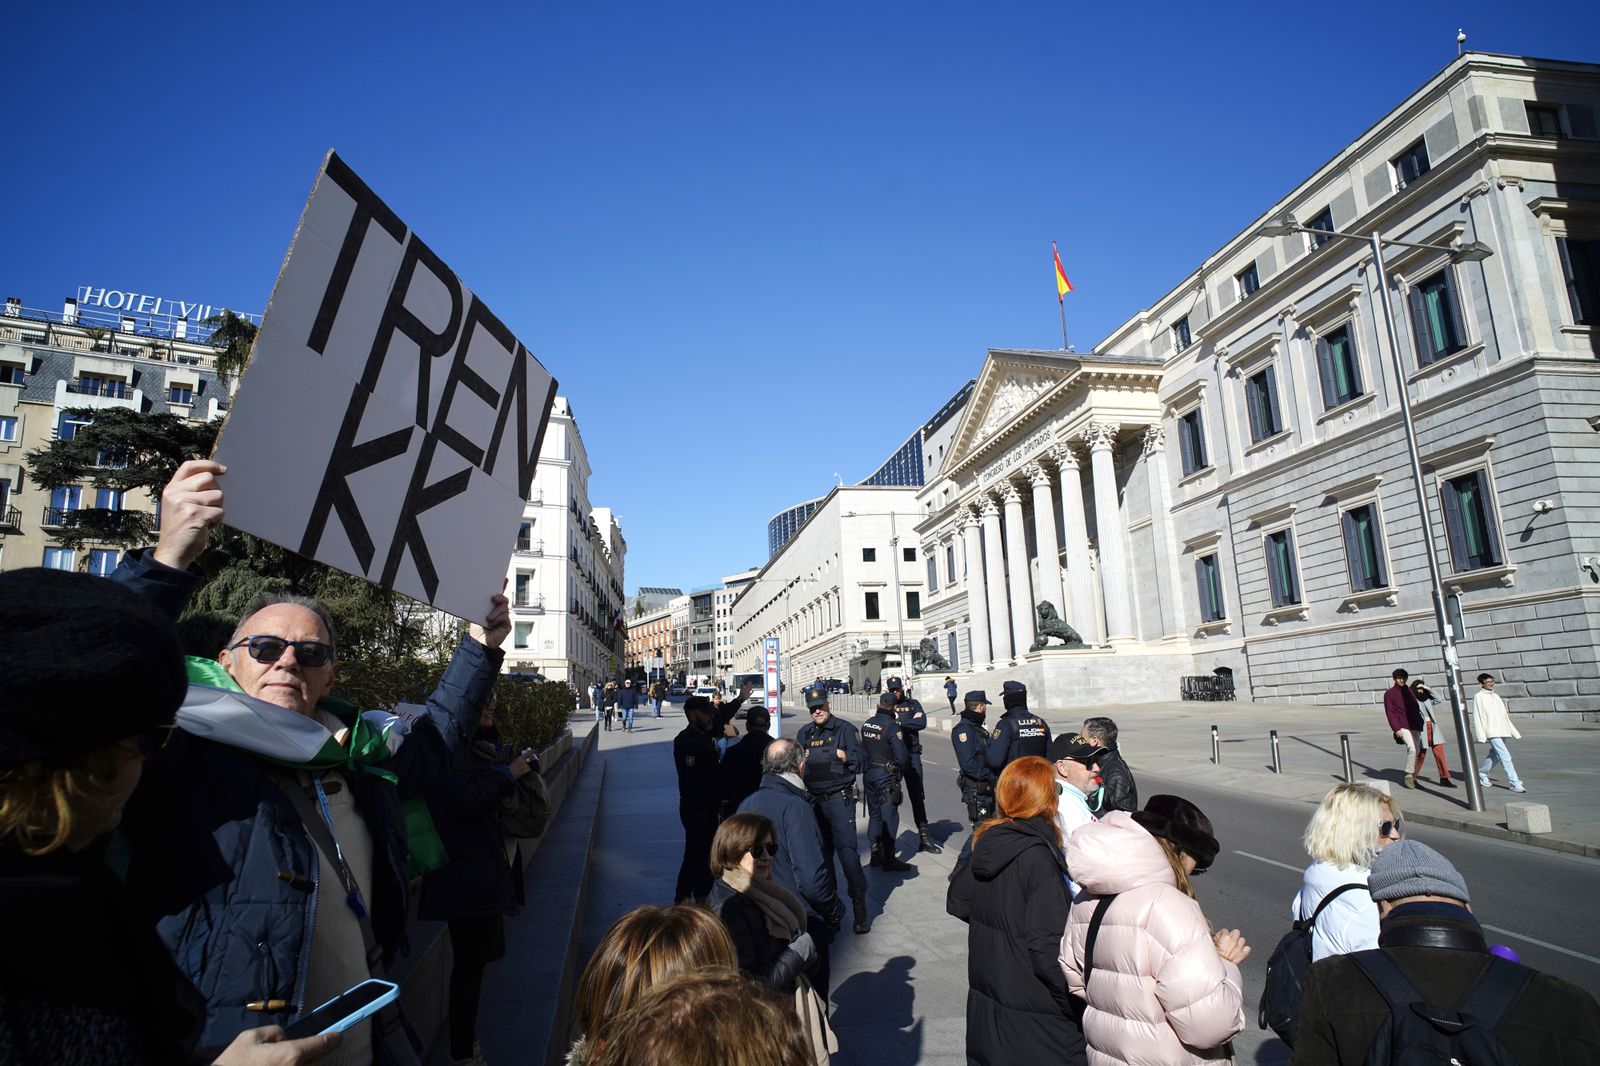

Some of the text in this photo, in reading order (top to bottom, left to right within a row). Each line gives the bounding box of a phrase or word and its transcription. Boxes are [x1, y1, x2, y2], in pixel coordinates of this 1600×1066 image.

[83, 286, 162, 315] HOTEL
[307, 150, 558, 501] TREN
[300, 382, 439, 606] KK
[1005, 457, 1011, 468] DE
[1013, 450, 1022, 462] LOS
[1024, 430, 1051, 455] DIPUTADOS
